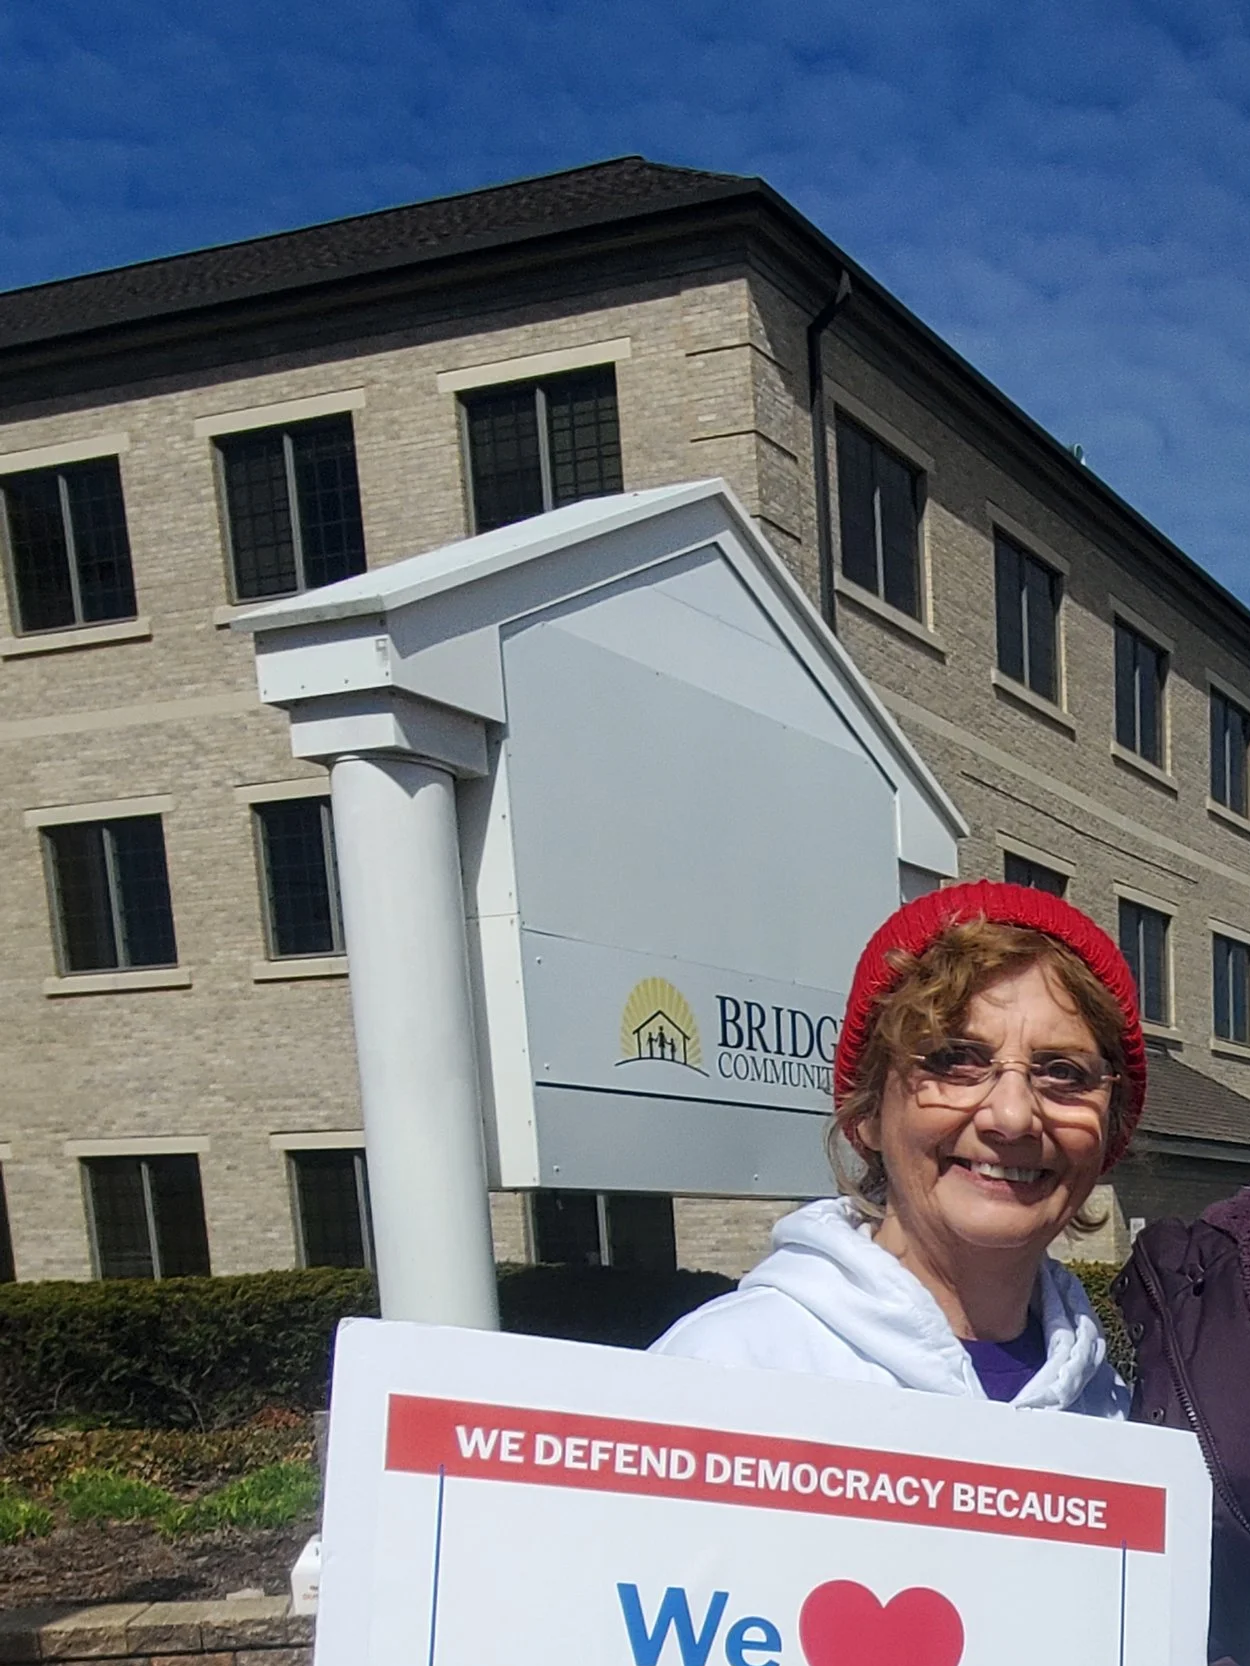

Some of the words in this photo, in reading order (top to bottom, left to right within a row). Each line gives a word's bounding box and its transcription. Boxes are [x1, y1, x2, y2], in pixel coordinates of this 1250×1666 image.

[716, 994, 841, 1064] BRIDG
[717, 1051, 834, 1091] COMMUNIT
[455, 1425, 526, 1464] WE
[533, 1433, 697, 1480] DEFEND
[705, 1452, 945, 1509] DEMOCRACY
[952, 1482, 1107, 1529] BECAUSE
